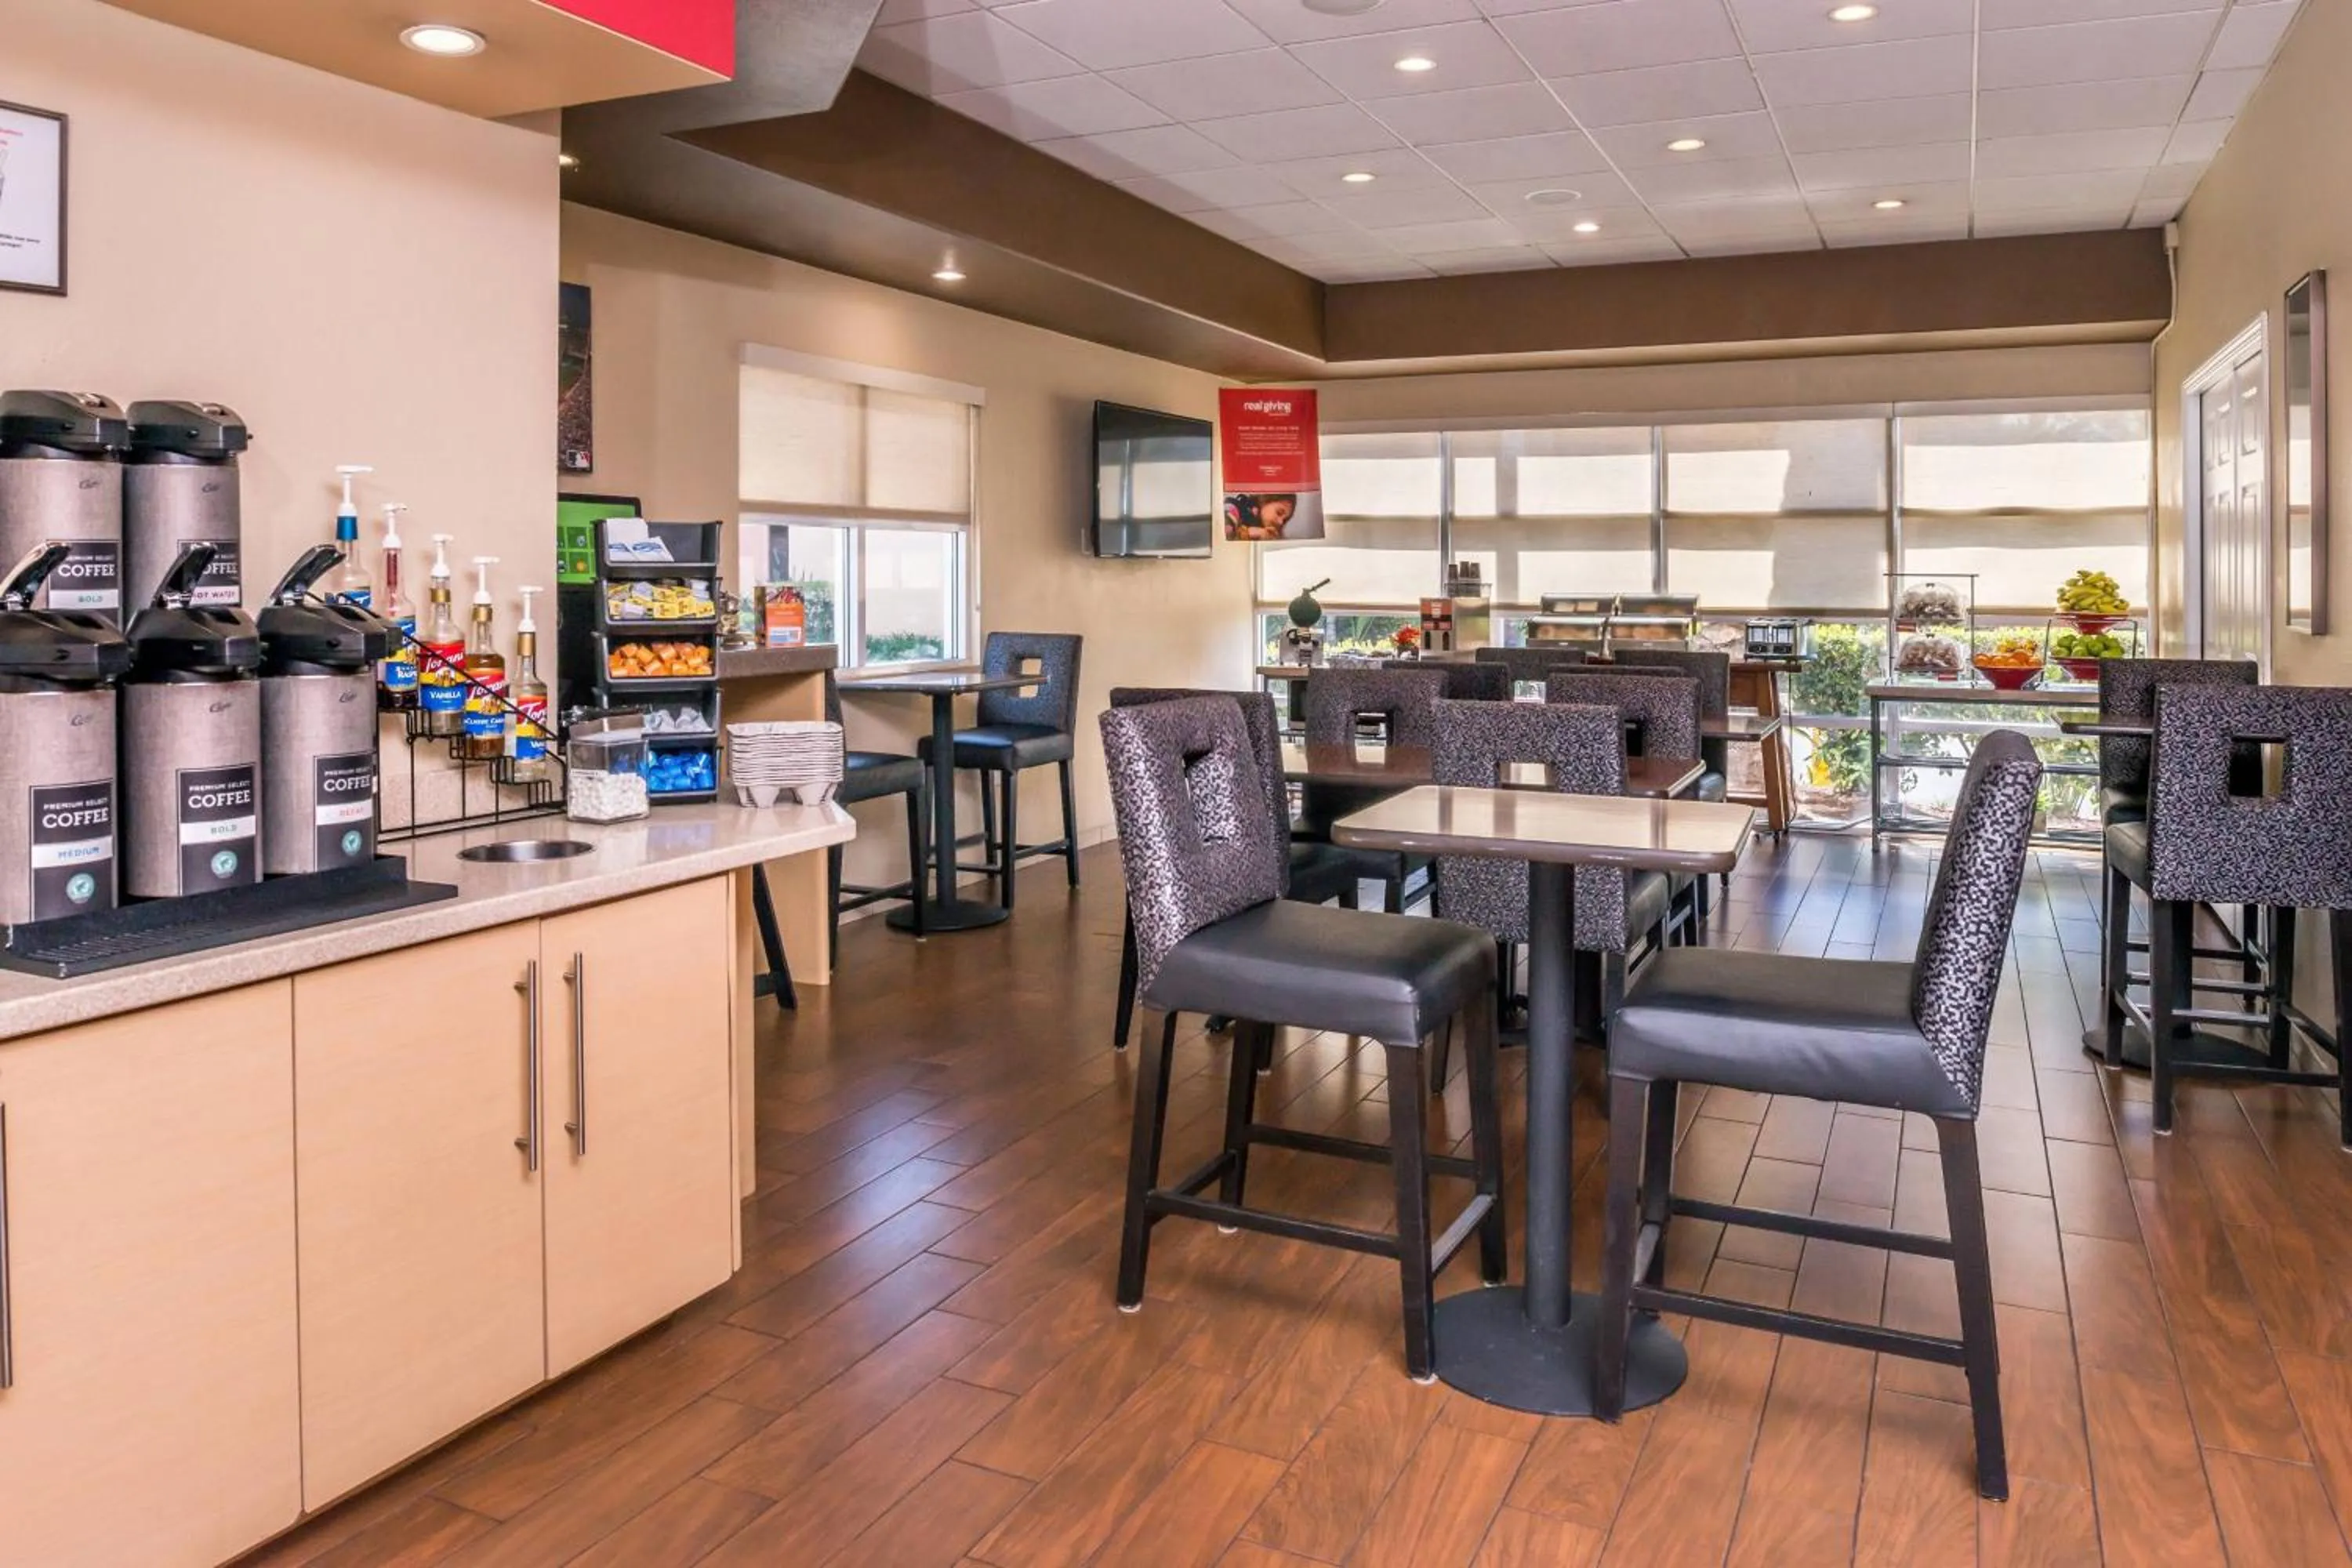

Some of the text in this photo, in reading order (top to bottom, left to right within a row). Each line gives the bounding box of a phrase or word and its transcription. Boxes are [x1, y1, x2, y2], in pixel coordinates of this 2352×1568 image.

[58, 564, 115, 577] COFFEE
[202, 562, 238, 575] OFFEE
[228, 780, 251, 789] SELECT
[323, 774, 372, 792] COFFEE
[43, 797, 108, 811] PREMIUM SELECT
[187, 789, 252, 809] COFFEE
[42, 808, 109, 829] COFFEE
[210, 824, 237, 835] BOLD
[57, 846, 100, 859] MEDIUM
